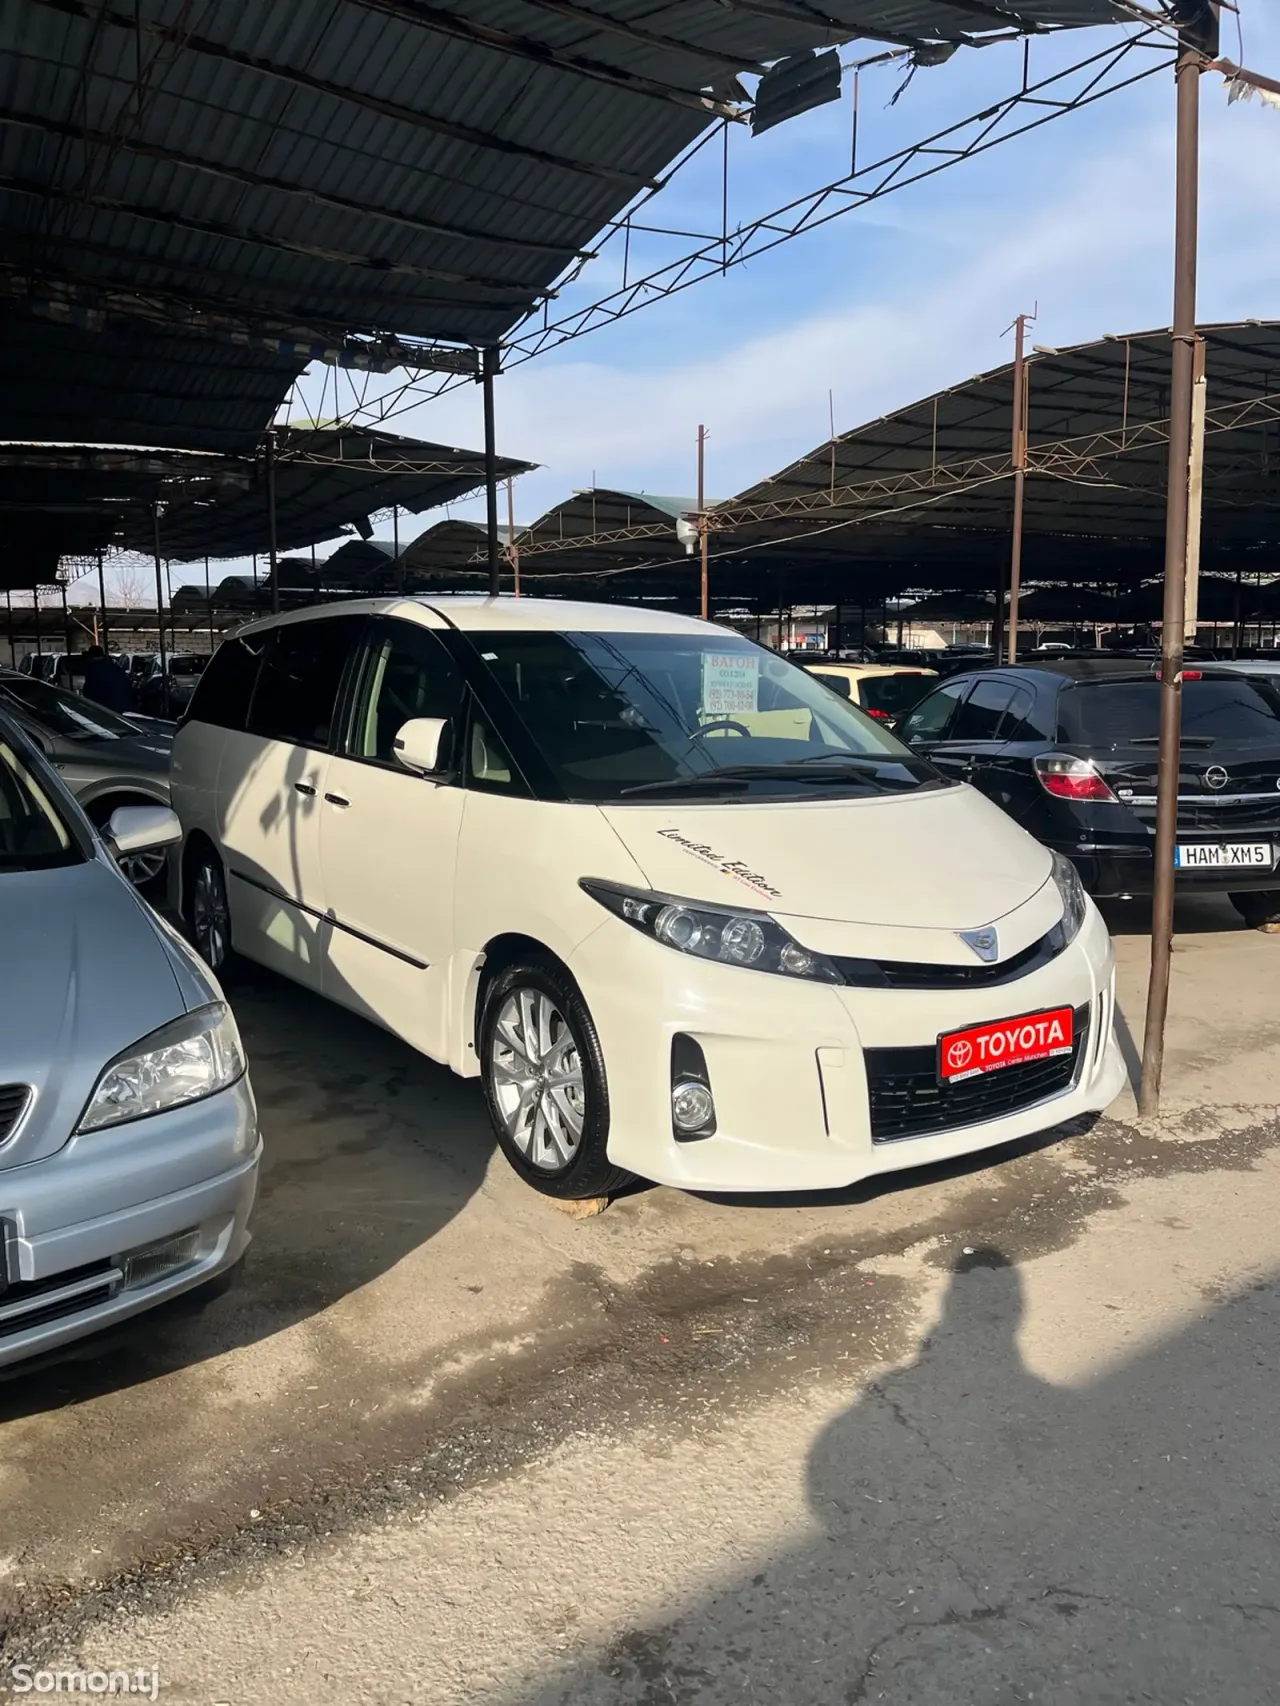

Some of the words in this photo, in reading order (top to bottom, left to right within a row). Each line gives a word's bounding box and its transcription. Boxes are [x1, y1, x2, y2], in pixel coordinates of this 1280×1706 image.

[711, 655, 755, 669] ВАГОН
[656, 828, 725, 862] Limited
[721, 860, 783, 898] Edition
[1186, 847, 1219, 864] HAM
[1230, 847, 1251, 864] XM
[1254, 846, 1264, 863] 5
[976, 1019, 1064, 1060] TOYOTA
[985, 1061, 1007, 1072] TOYOTA
